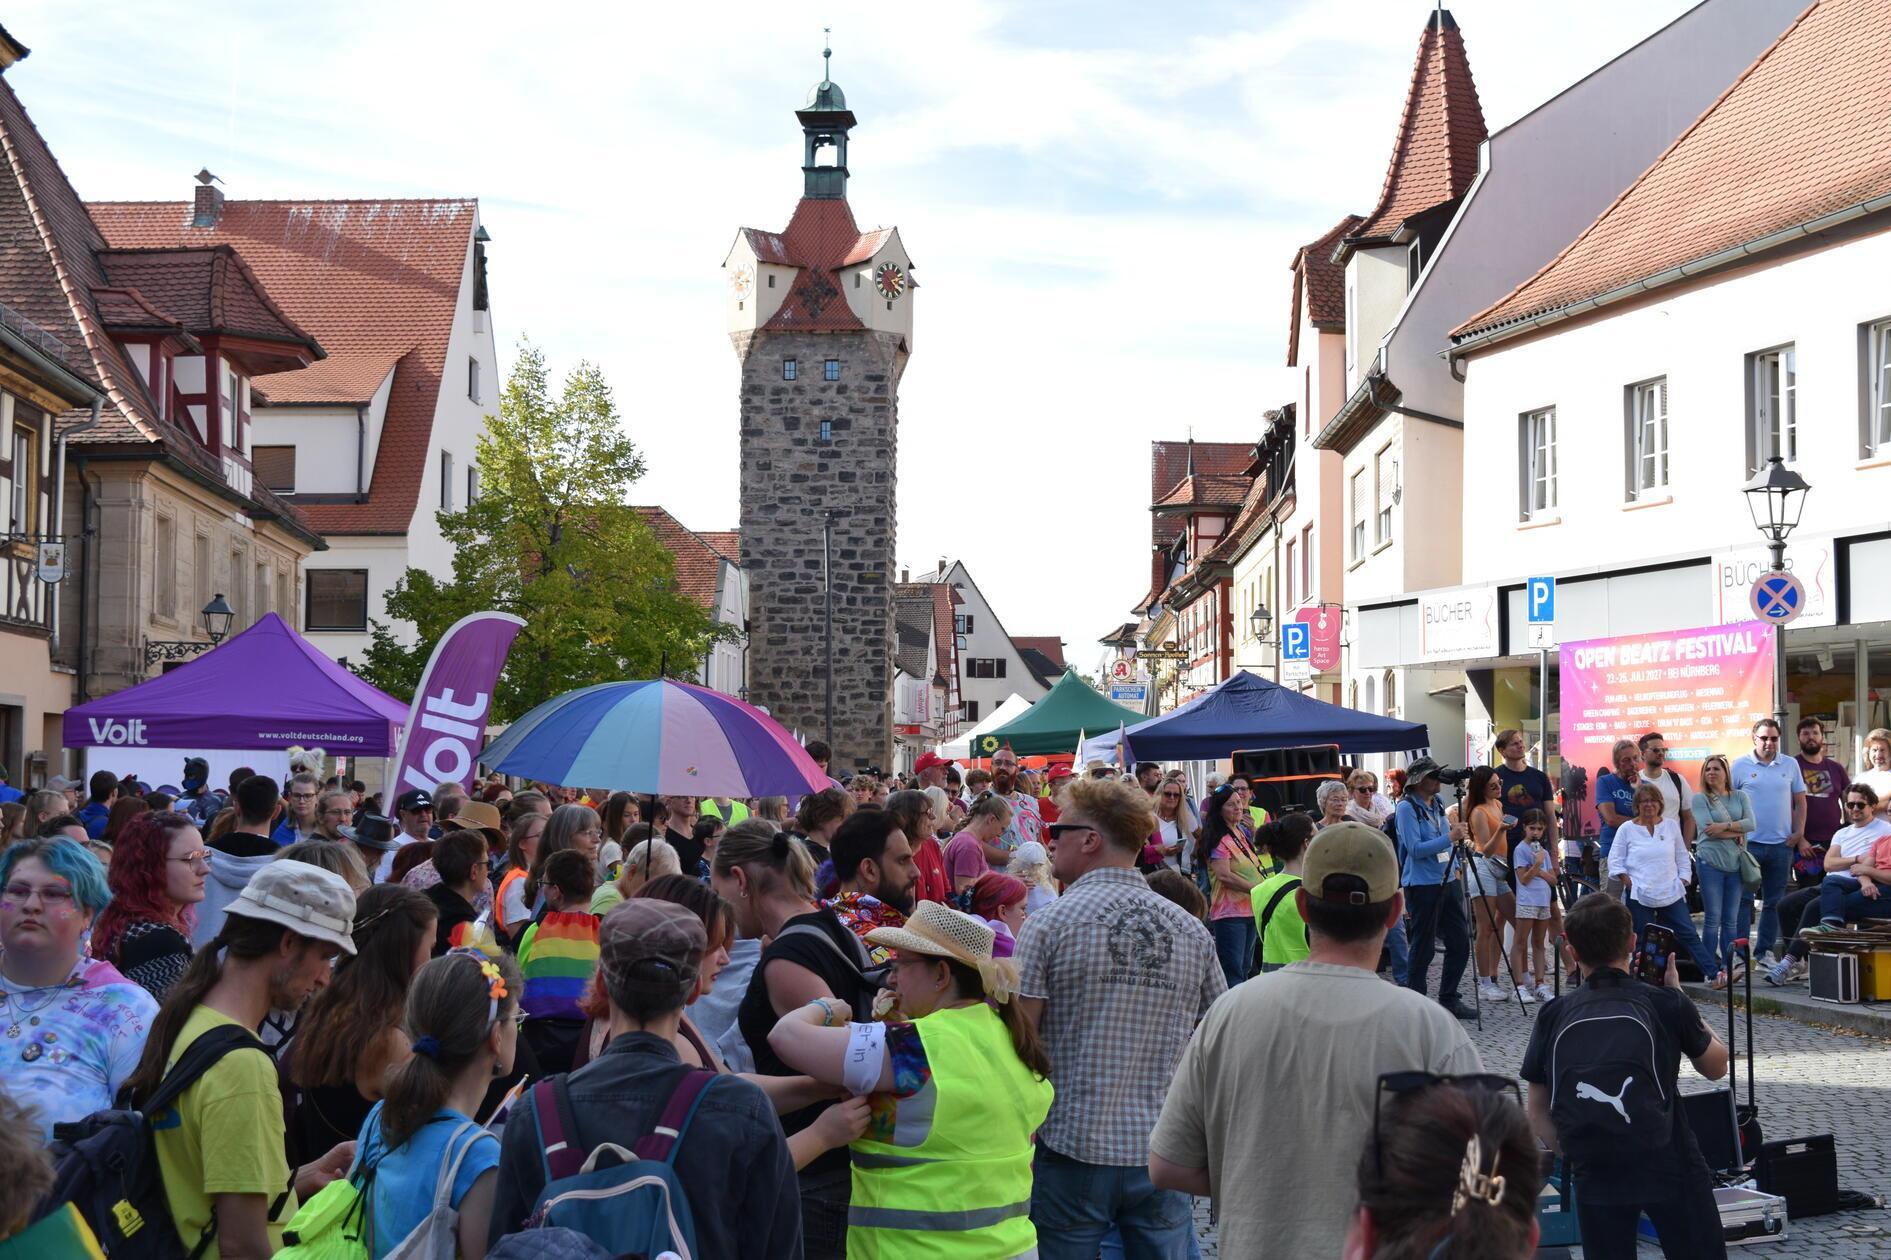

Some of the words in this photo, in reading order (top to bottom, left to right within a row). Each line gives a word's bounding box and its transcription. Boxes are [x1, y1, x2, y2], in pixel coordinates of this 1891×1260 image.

[1724, 557, 1794, 588] BÜCHR
[1533, 582, 1549, 617] P
[1287, 627, 1304, 655] P
[1574, 646, 1617, 670] OPEN
[1620, 640, 1671, 666] BEATZ
[1675, 630, 1757, 661] FESTIVAL
[1630, 669, 1646, 683] JULI
[1646, 668, 1662, 682] 2027
[1667, 667, 1680, 679] BEI
[1680, 664, 1721, 679] NÜRNBERG
[88, 717, 149, 745] Volt
[258, 731, 364, 744] www.voltdeutschland.org
